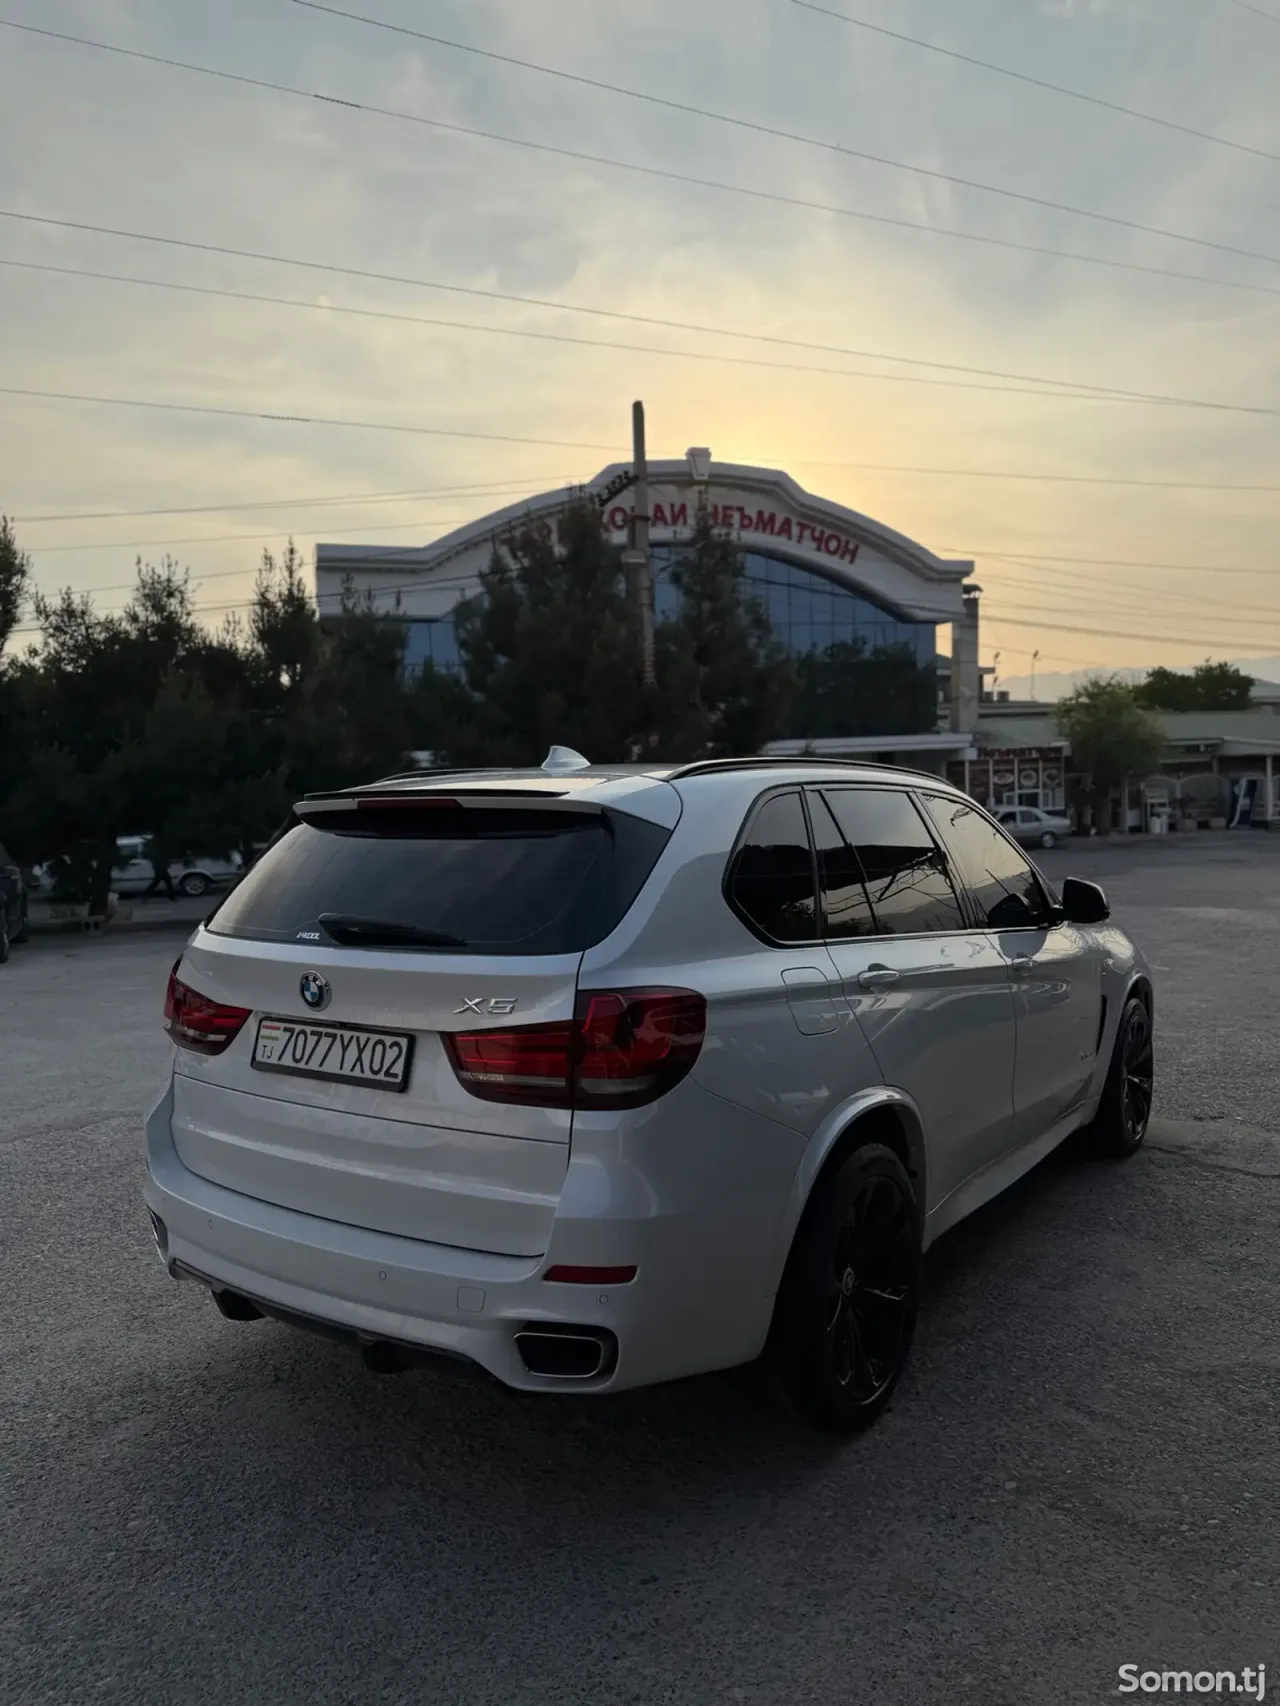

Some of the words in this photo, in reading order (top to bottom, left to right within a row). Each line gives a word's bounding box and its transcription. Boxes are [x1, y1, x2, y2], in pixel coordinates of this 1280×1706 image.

[452, 997, 518, 1015] X5
[261, 1044, 274, 1059] TJ
[277, 1026, 403, 1079] 7077YX02
